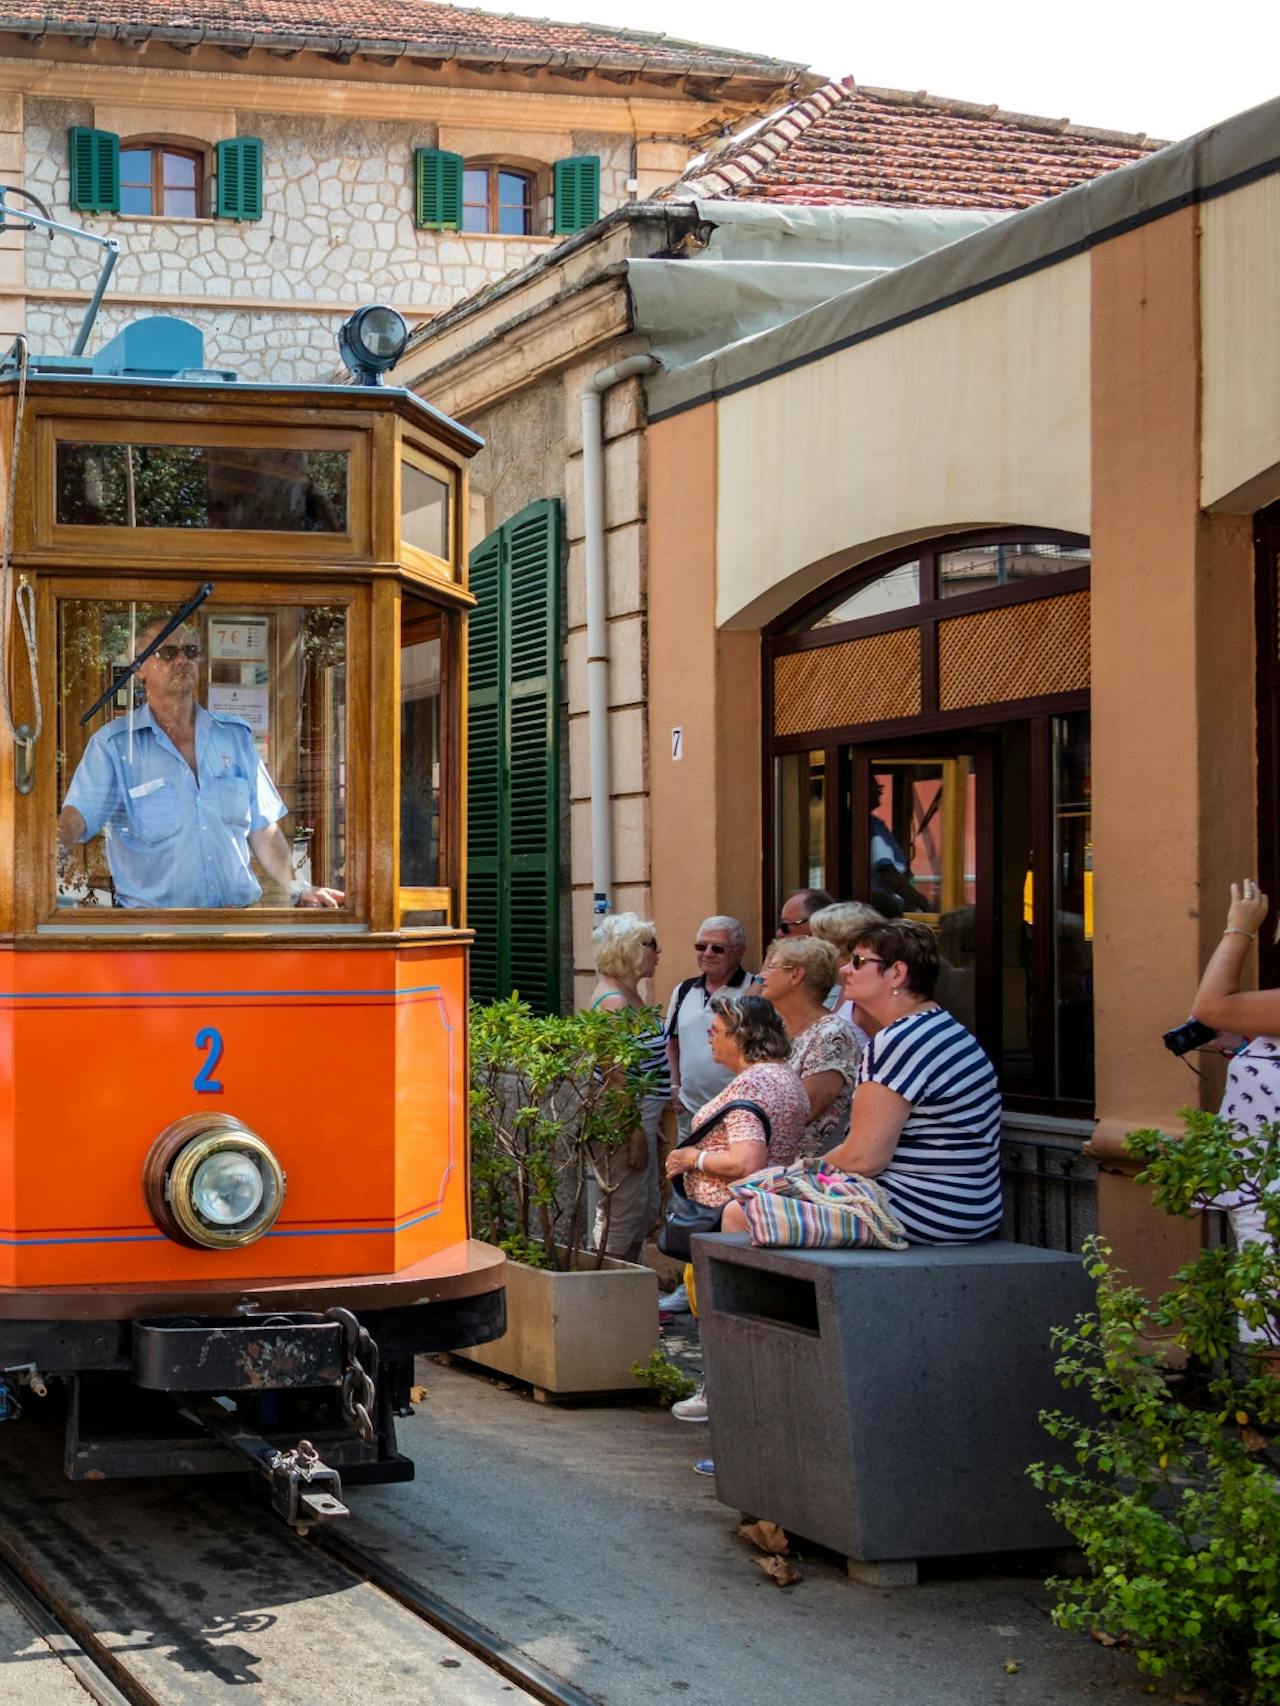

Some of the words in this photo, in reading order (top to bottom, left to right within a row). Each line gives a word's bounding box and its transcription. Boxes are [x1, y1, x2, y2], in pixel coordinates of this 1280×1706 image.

[217, 629, 226, 645] 7
[231, 630, 240, 645] €
[672, 730, 681, 757] 7
[193, 1027, 224, 1094] 2
